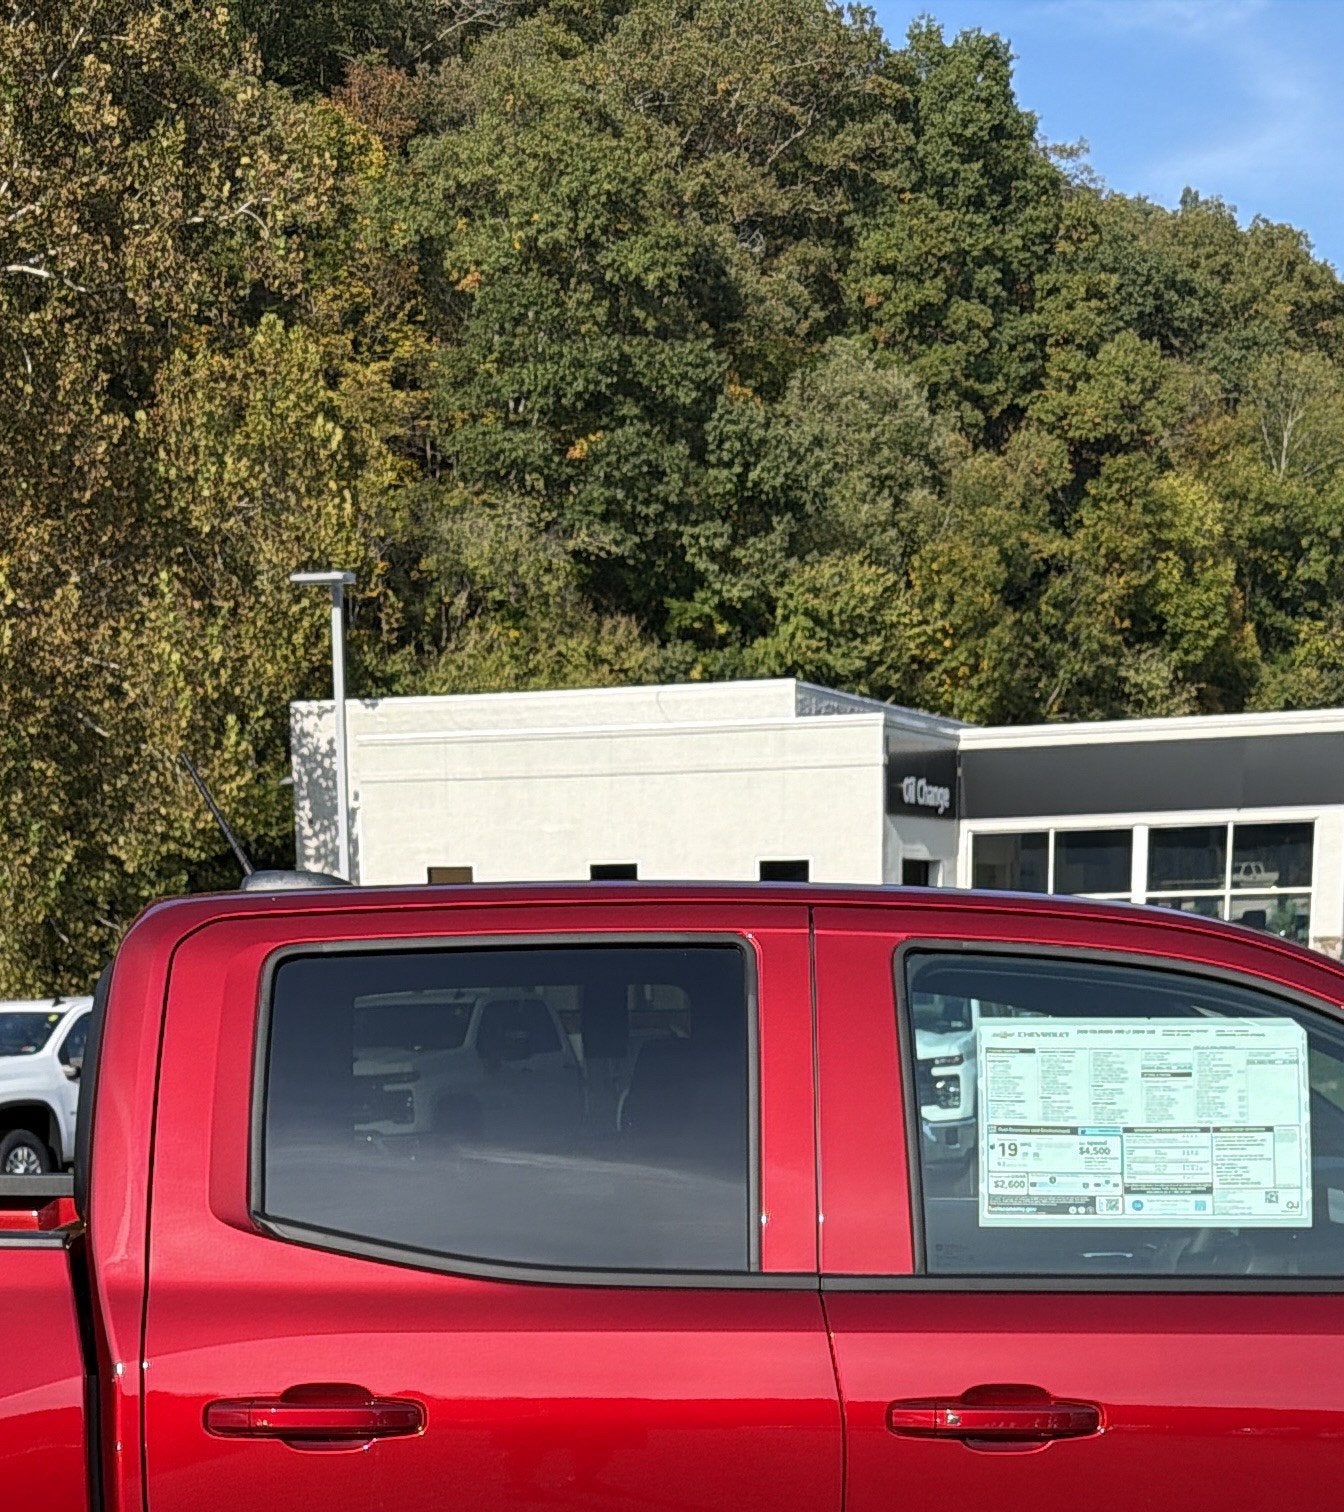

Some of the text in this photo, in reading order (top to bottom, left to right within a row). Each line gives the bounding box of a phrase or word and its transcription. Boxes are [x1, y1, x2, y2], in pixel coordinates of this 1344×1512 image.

[917, 777, 951, 815] Change
[998, 1142, 1018, 1157] 19
[1078, 1146, 1112, 1156] $4,500
[993, 1179, 1026, 1189] $2,600
